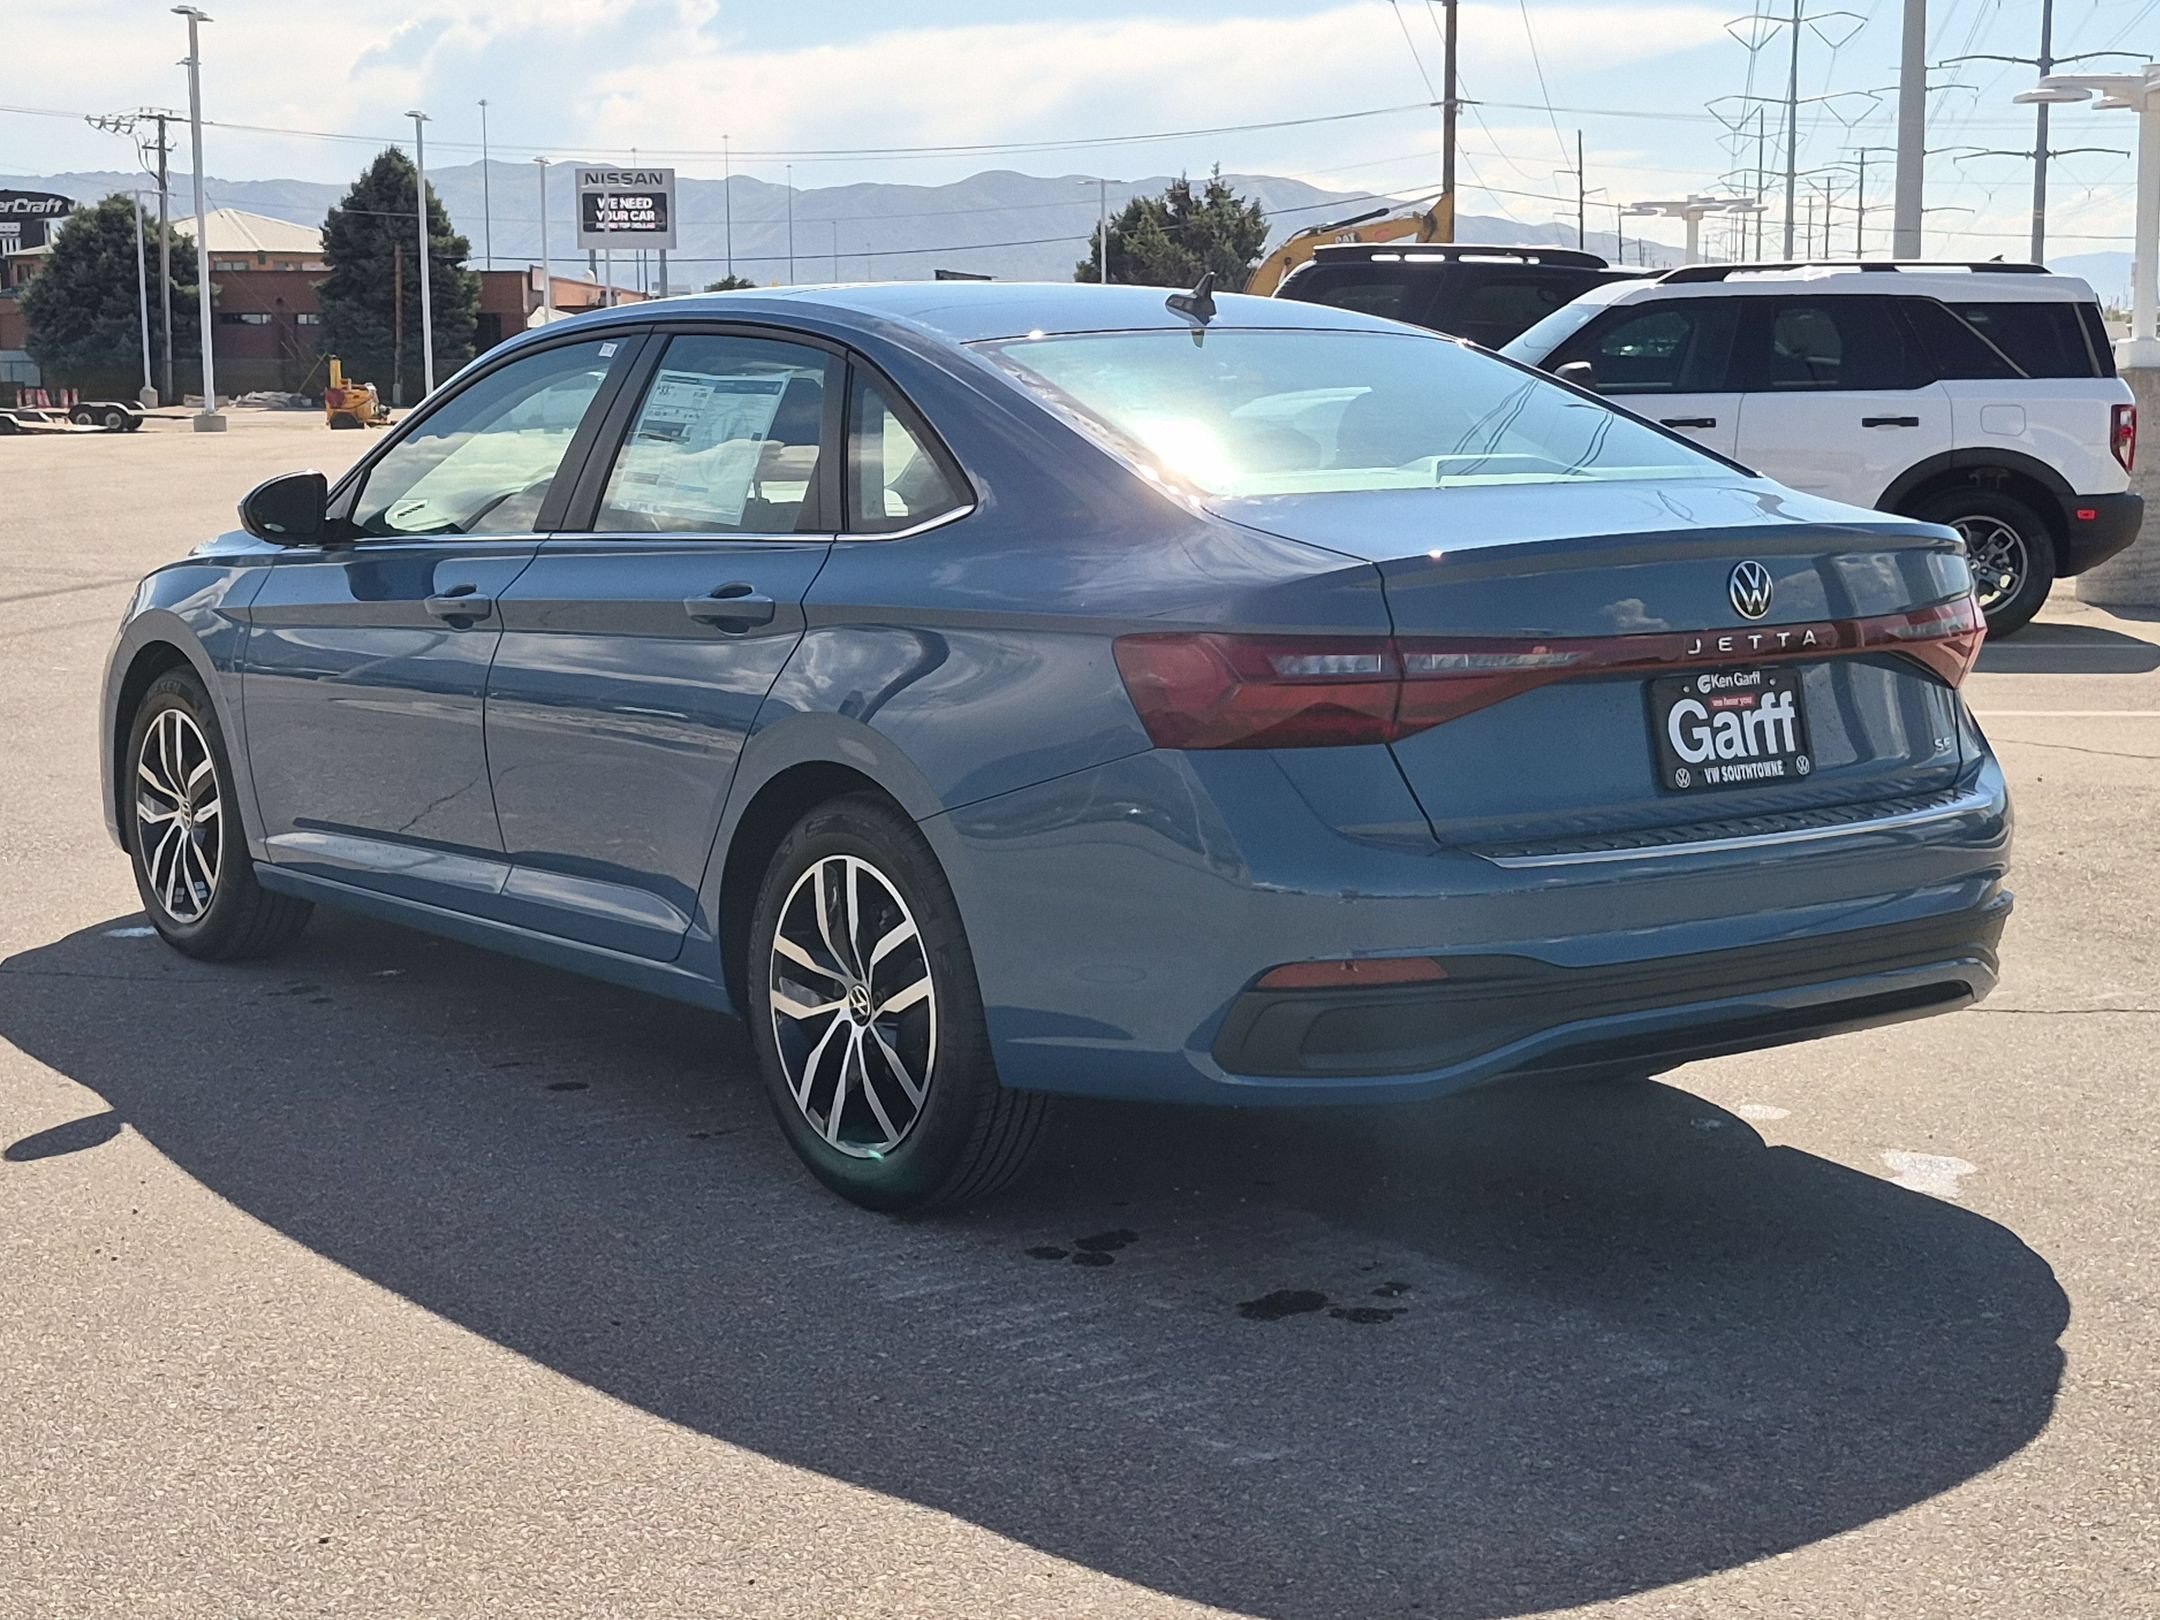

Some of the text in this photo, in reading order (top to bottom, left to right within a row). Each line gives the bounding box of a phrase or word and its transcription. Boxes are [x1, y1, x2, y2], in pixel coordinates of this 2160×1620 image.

[585, 172, 663, 185] NISSAN
[597, 197, 653, 209] WE NEED
[630, 210, 655, 221] CAR
[1688, 629, 1817, 655] JETTA
[1711, 670, 1760, 688] Ken Garff
[1668, 690, 1796, 764] Garff
[1704, 759, 1785, 784] VW SOUTHTOWNE
